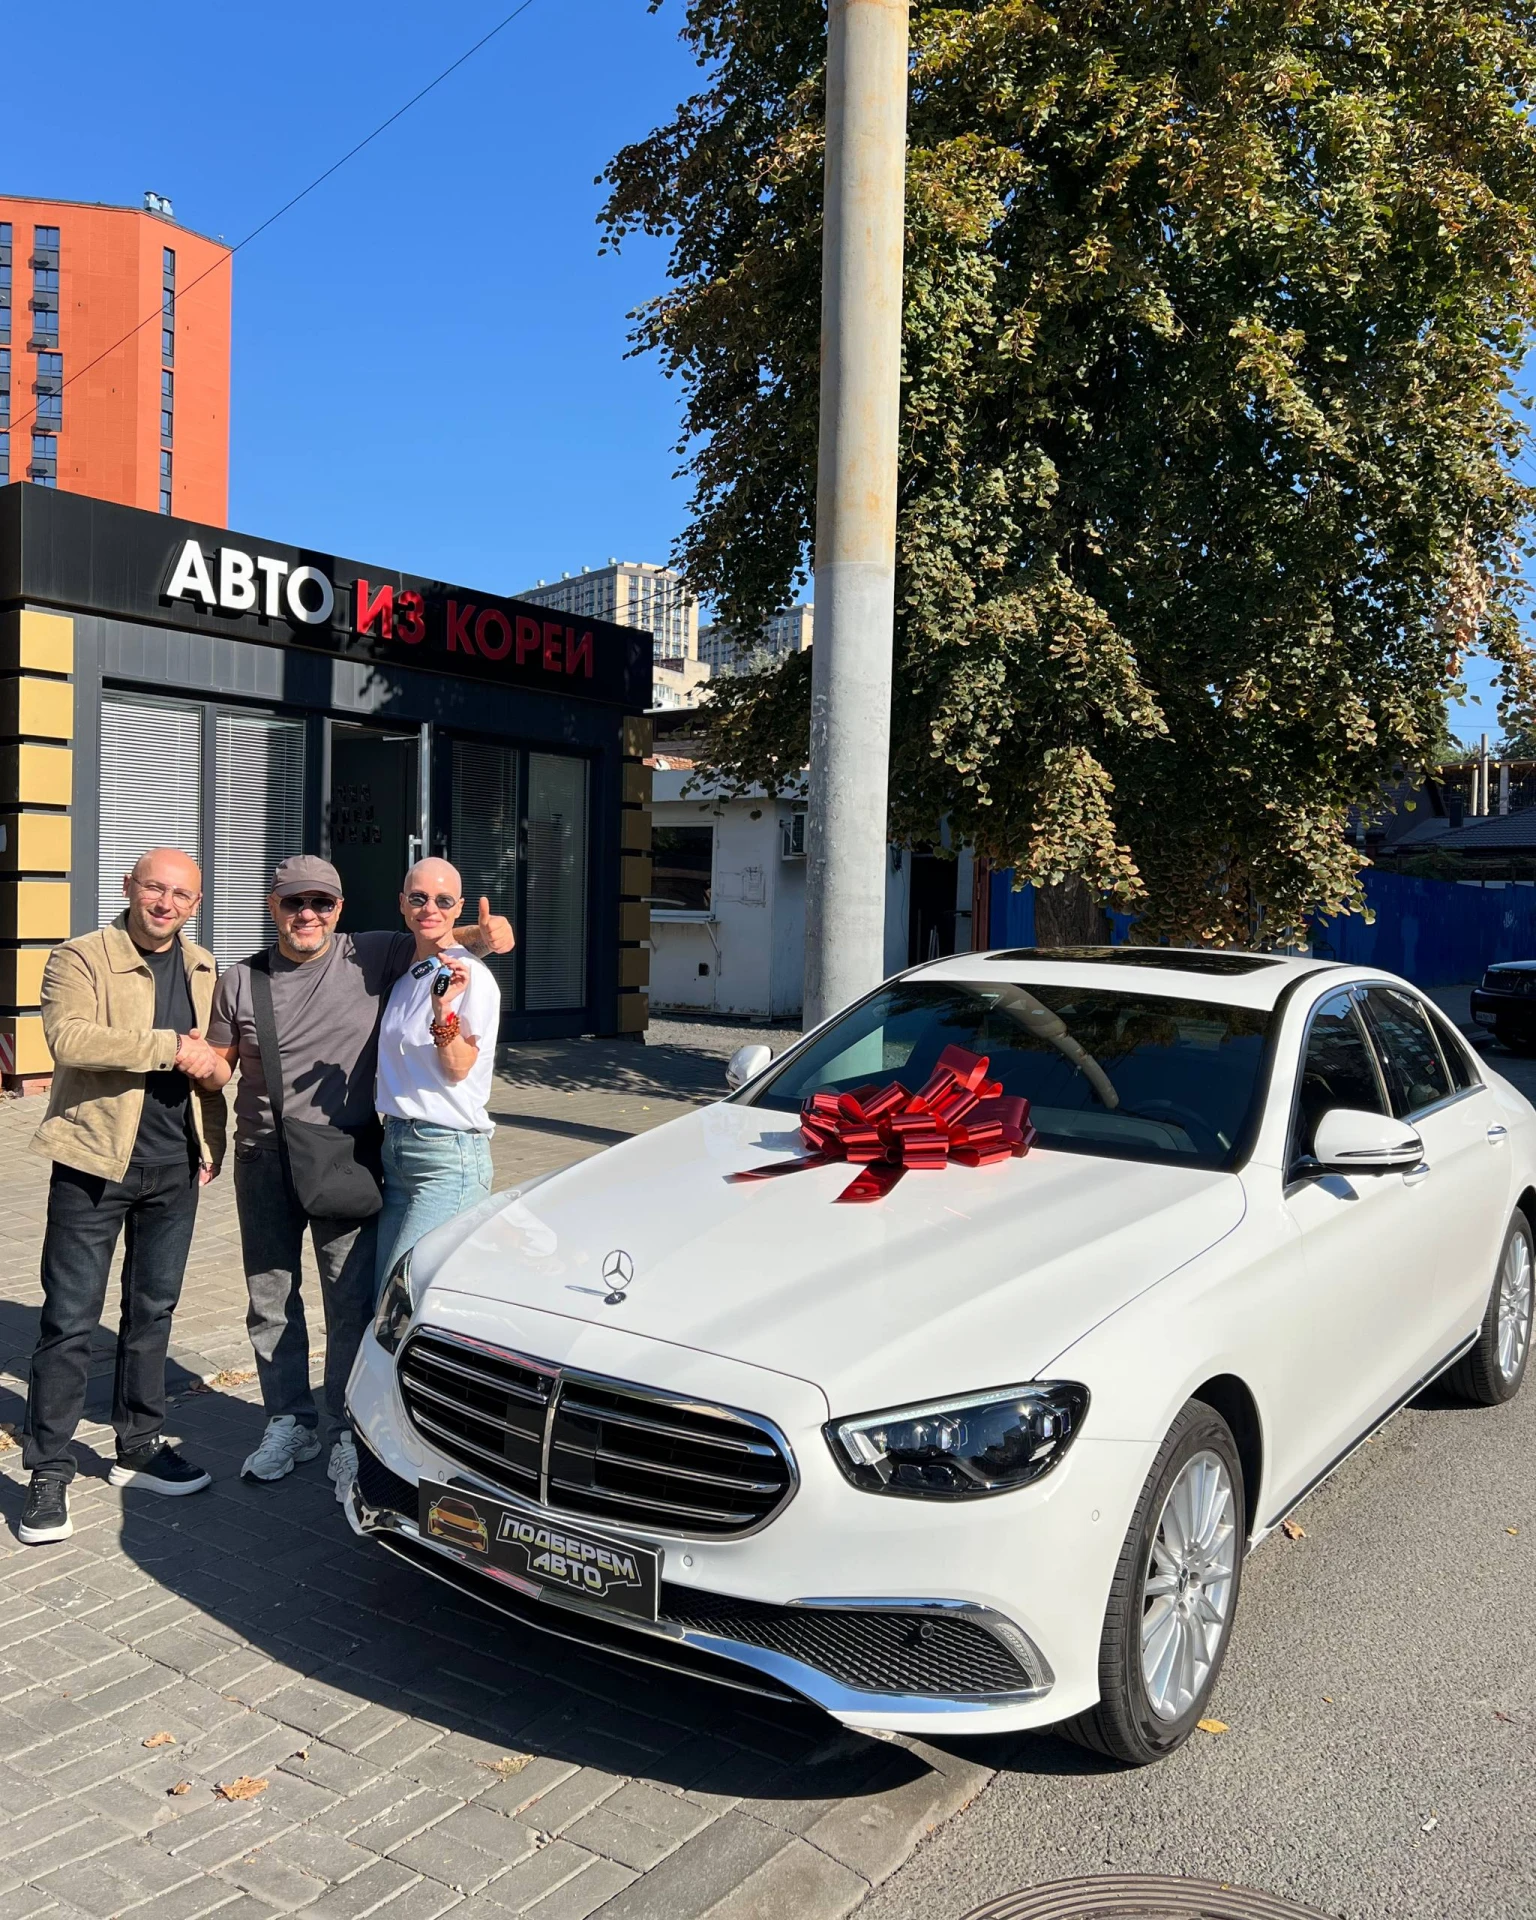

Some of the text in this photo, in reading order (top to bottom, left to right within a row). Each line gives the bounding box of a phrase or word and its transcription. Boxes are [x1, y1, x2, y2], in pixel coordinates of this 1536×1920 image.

[166, 539, 594, 679] АВТО ИЗ КОРЕИ
[502, 1518, 635, 1580] ПОДБЕРЕМ
[533, 1552, 602, 1589] АВТО
